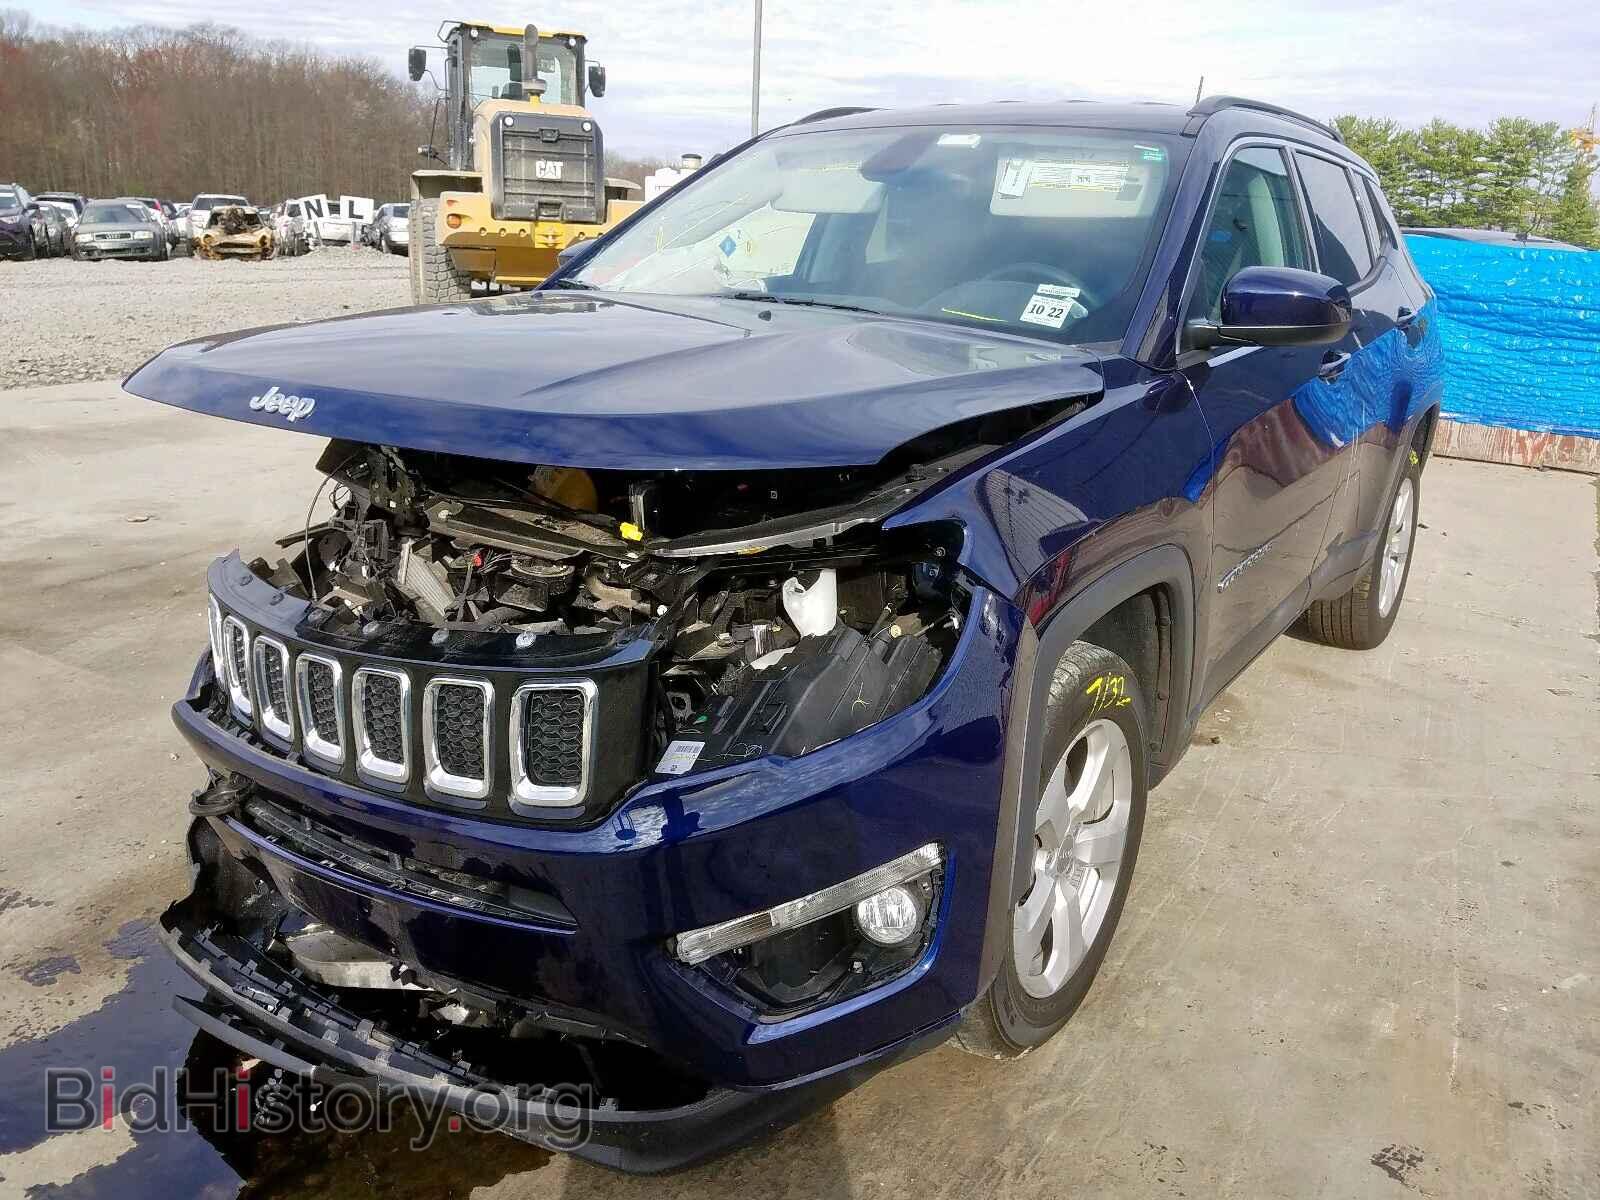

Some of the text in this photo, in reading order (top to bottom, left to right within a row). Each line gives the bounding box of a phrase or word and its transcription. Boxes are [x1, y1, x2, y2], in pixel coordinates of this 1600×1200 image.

[536, 160, 564, 179] CAT
[303, 199, 324, 220] N
[348, 200, 364, 219] L
[1028, 304, 1064, 318] 10 22
[249, 386, 316, 422] Jeep
